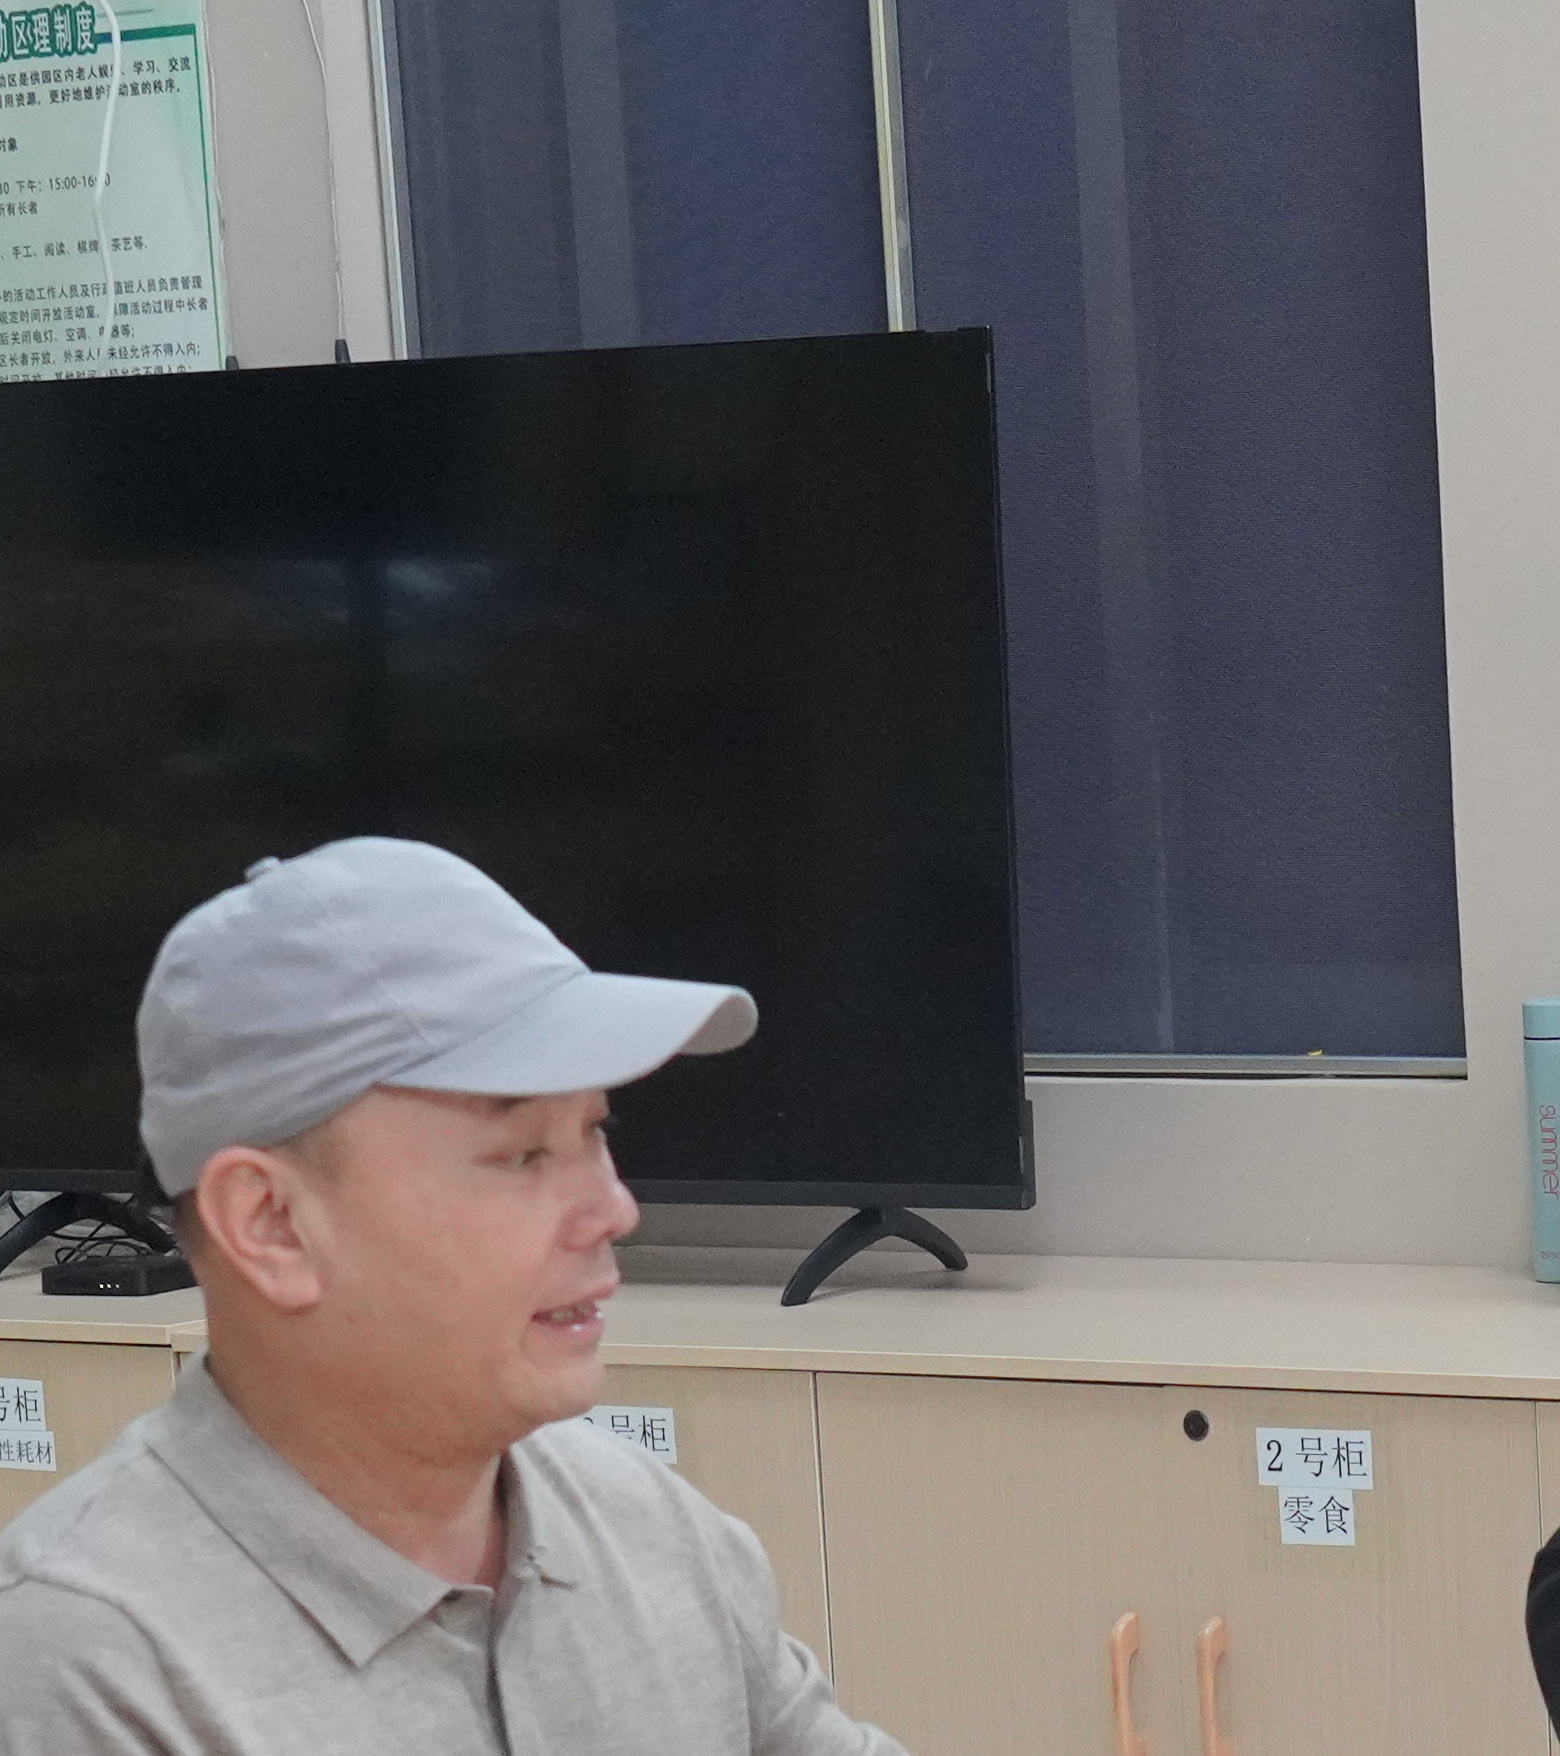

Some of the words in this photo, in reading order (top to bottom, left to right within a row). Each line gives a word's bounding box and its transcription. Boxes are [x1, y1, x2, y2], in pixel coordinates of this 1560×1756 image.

[1539, 1104, 1560, 1198] summer
[583, 1414, 670, 1452] 号柜
[1266, 1436, 1368, 1478] 2号柜
[1283, 1495, 1350, 1535] 零食
